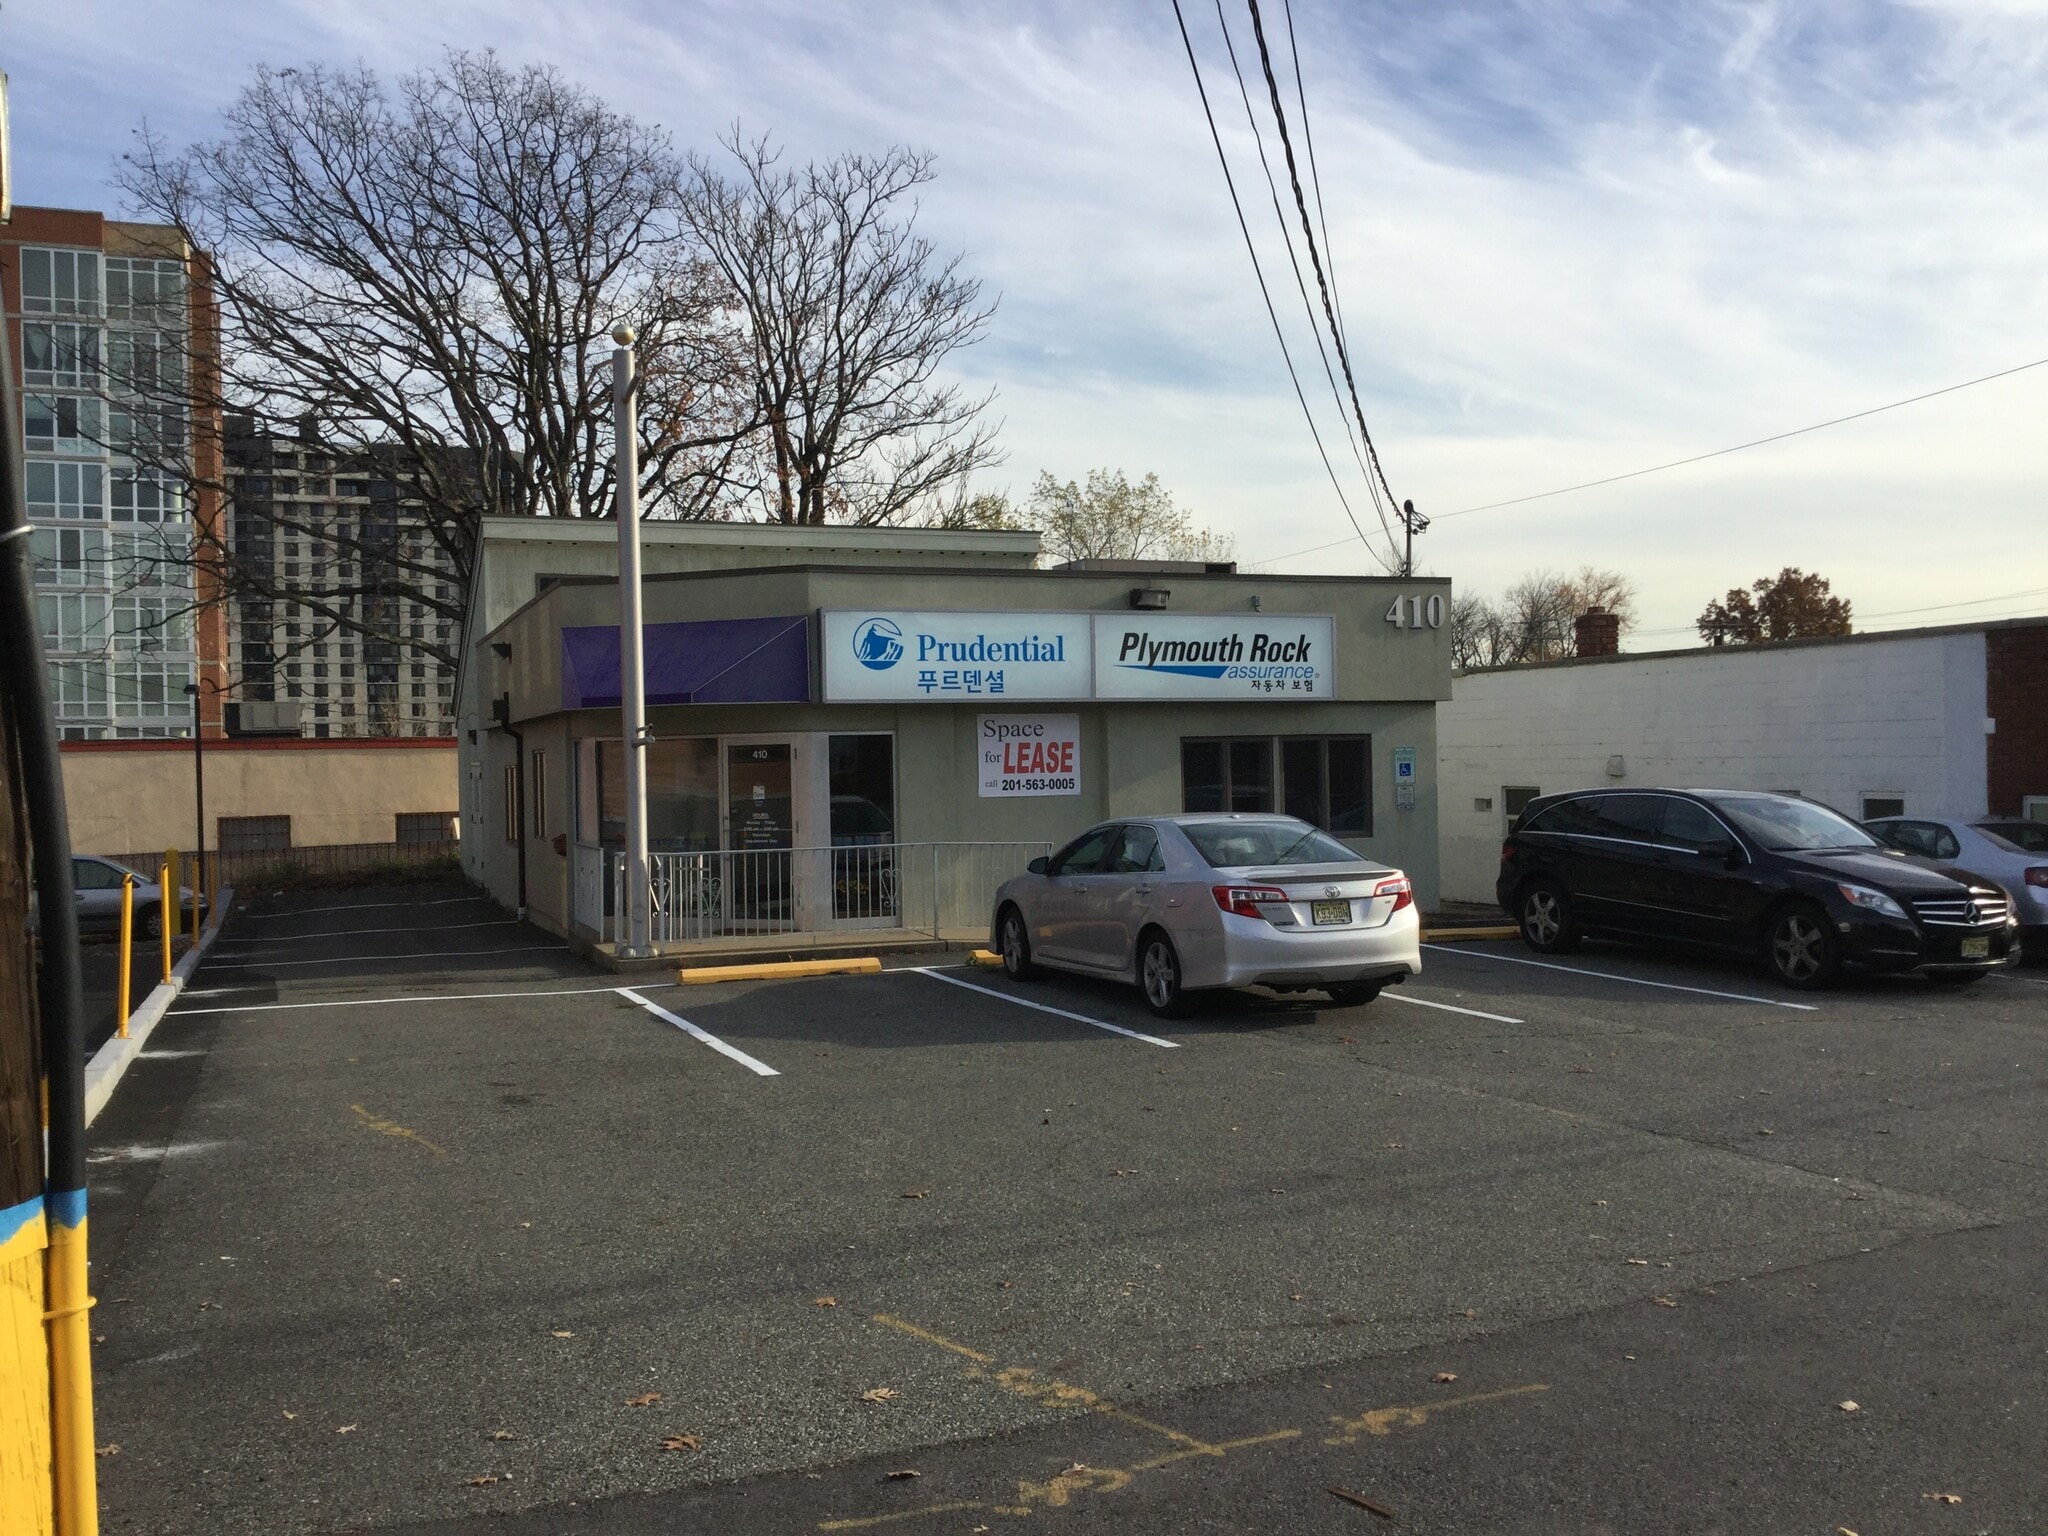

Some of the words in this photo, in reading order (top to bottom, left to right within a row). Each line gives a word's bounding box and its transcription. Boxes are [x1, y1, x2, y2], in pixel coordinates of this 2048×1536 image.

[1385, 594, 1446, 628] 410
[916, 634, 1065, 662] Prudential
[1119, 632, 1244, 669] Plymouth
[1249, 634, 1312, 662] Rock
[917, 669, 1005, 693] 푸르덴셜
[1228, 665, 1314, 679] assurance
[1251, 680, 1285, 692] 자동차
[1291, 680, 1313, 692] 보험
[983, 719, 1044, 742] Space
[752, 750, 768, 759] 410
[985, 751, 1001, 763] for
[1003, 742, 1074, 774] LEASE
[985, 780, 998, 788] call
[1002, 778, 1075, 791] 201-563-0005
